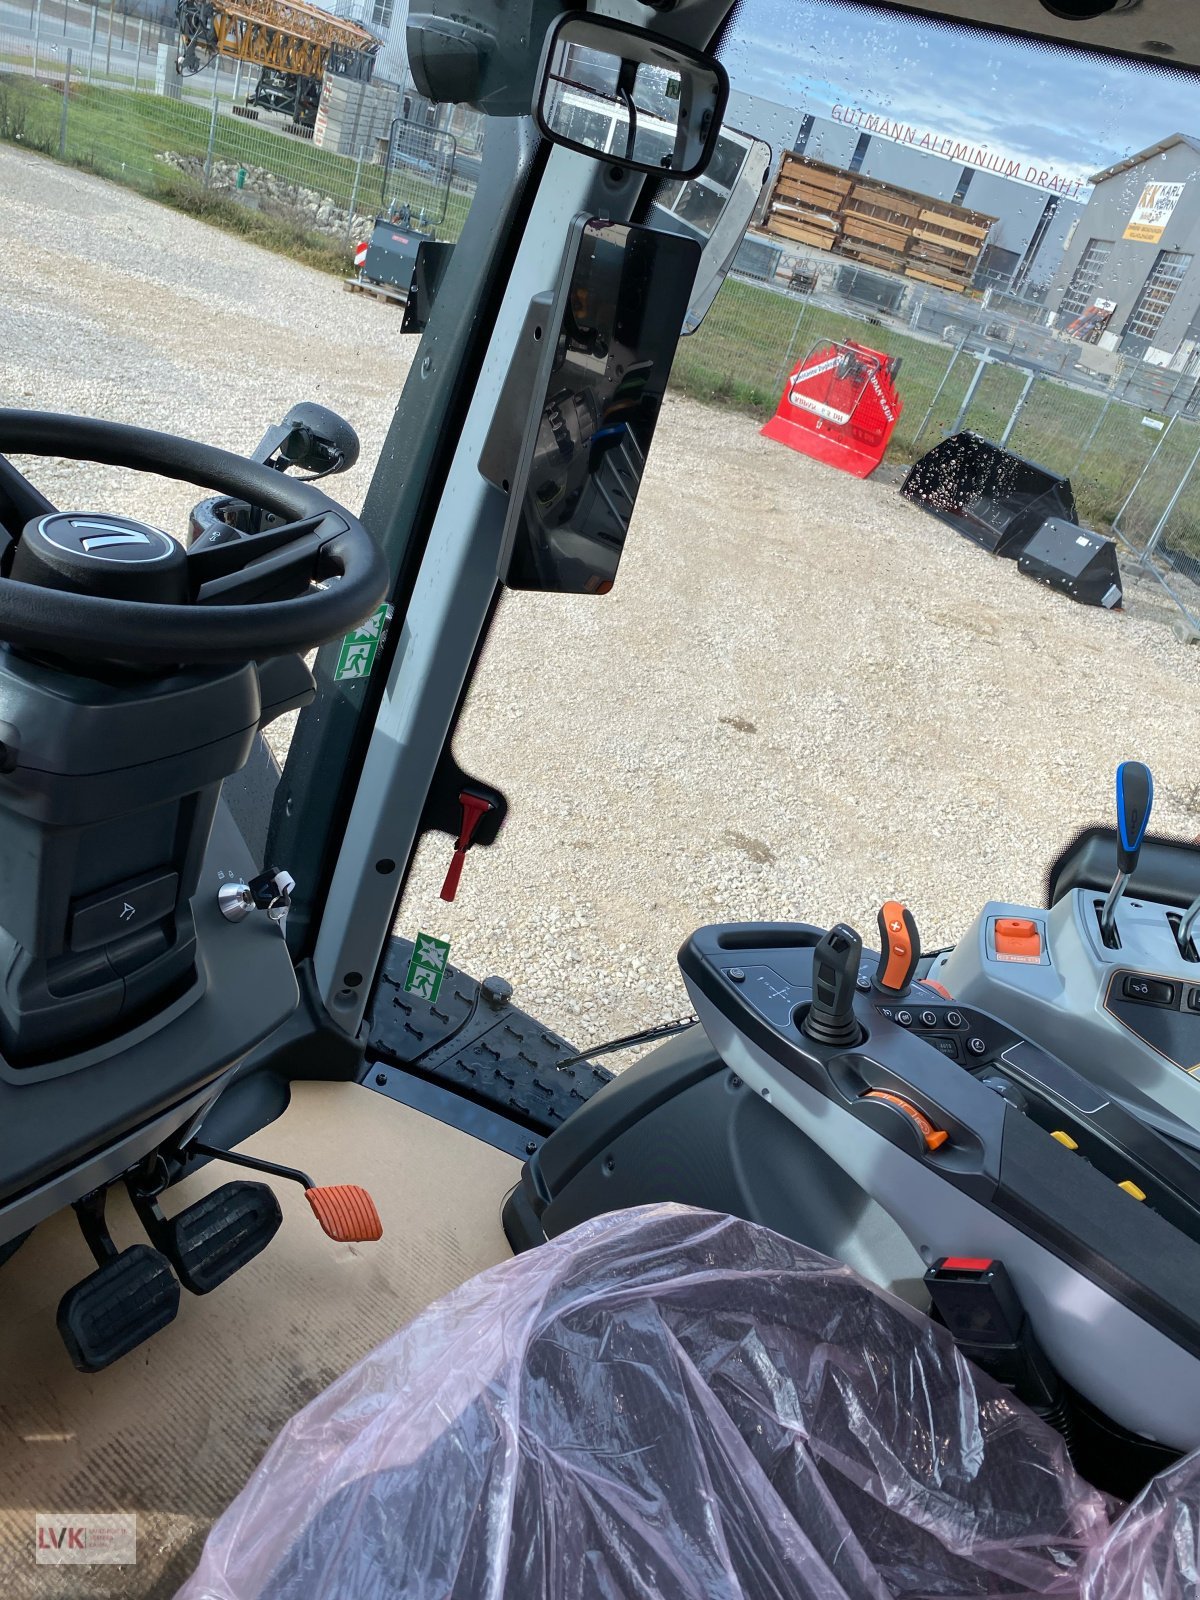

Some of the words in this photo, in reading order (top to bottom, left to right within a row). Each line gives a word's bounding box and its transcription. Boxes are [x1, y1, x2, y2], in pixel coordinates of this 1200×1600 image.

[831, 99, 916, 144] GUTMANN
[919, 132, 1021, 178] ALUMINIUM
[1024, 166, 1084, 198] DRAHT
[1160, 185, 1182, 197] KARL
